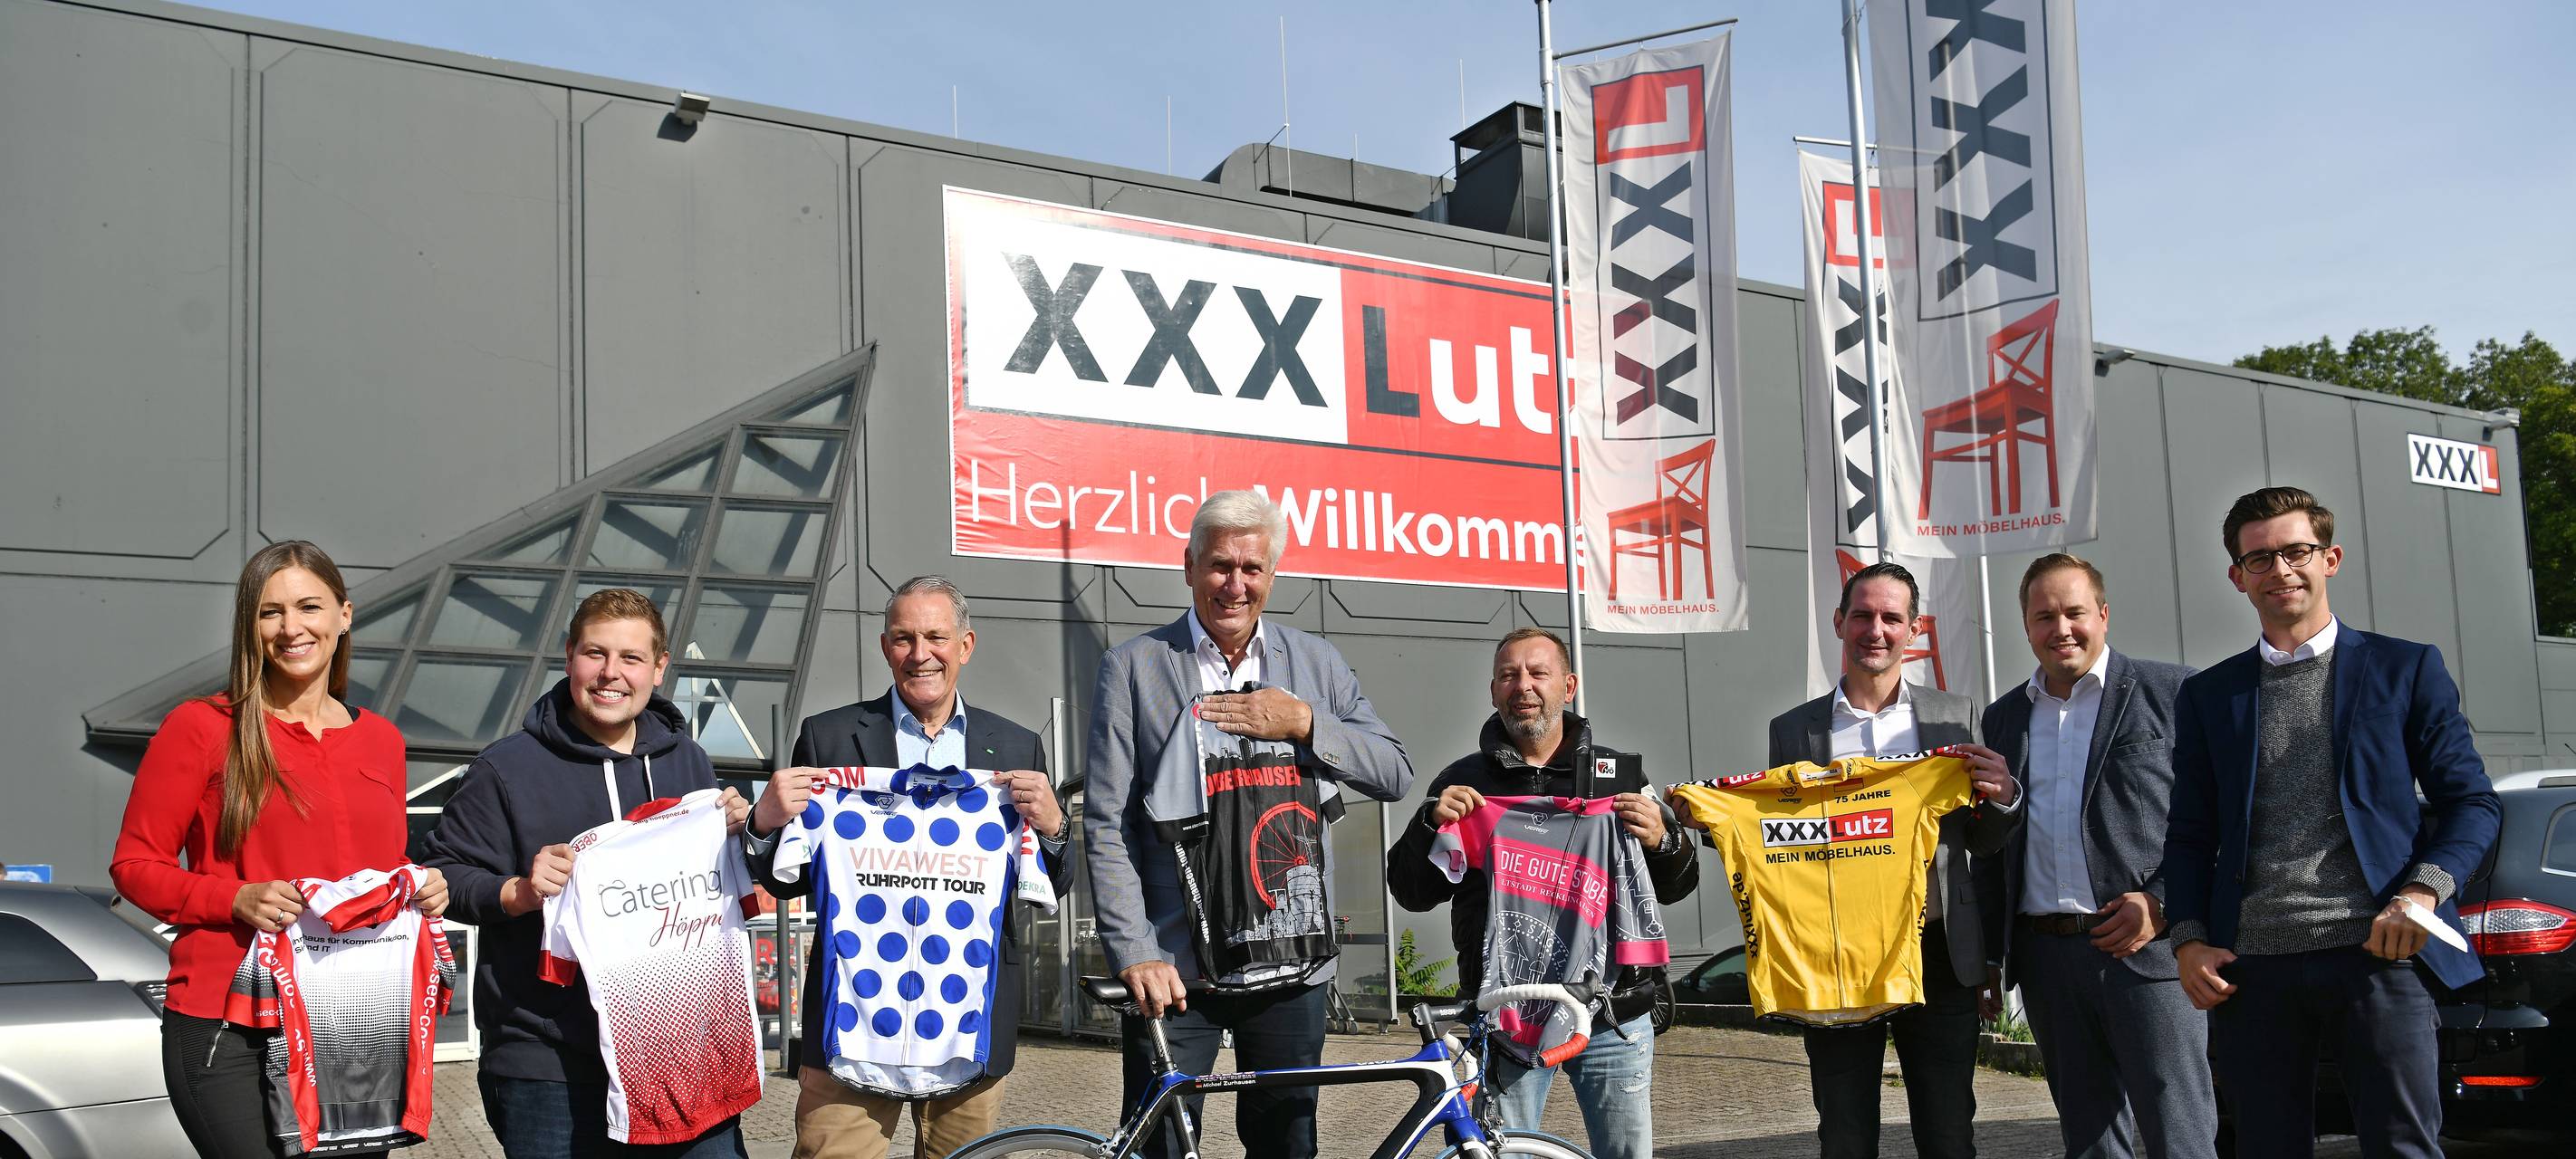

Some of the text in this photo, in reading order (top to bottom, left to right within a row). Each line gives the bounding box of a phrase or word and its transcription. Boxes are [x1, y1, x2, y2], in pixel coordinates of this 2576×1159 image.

[1608, 85, 1699, 425] XXXL
[2413, 440, 2498, 489] XXXL
[971, 459, 1207, 540] Herzlic
[1917, 512, 2066, 536] MEIN MÖBELHAUS.
[1607, 603, 1719, 615] MEIN MÖBELHAUS.
[1852, 790, 1891, 802] JAHRE
[849, 847, 989, 878] VIVAWEST
[1766, 845, 1896, 864] MEIN MÖBELHAUS.
[856, 873, 986, 895] RUHRPOTT TOUR
[1501, 851, 1608, 905] DIE GUTE STUBE
[599, 869, 723, 917] Catering
[327, 934, 340, 943] für
